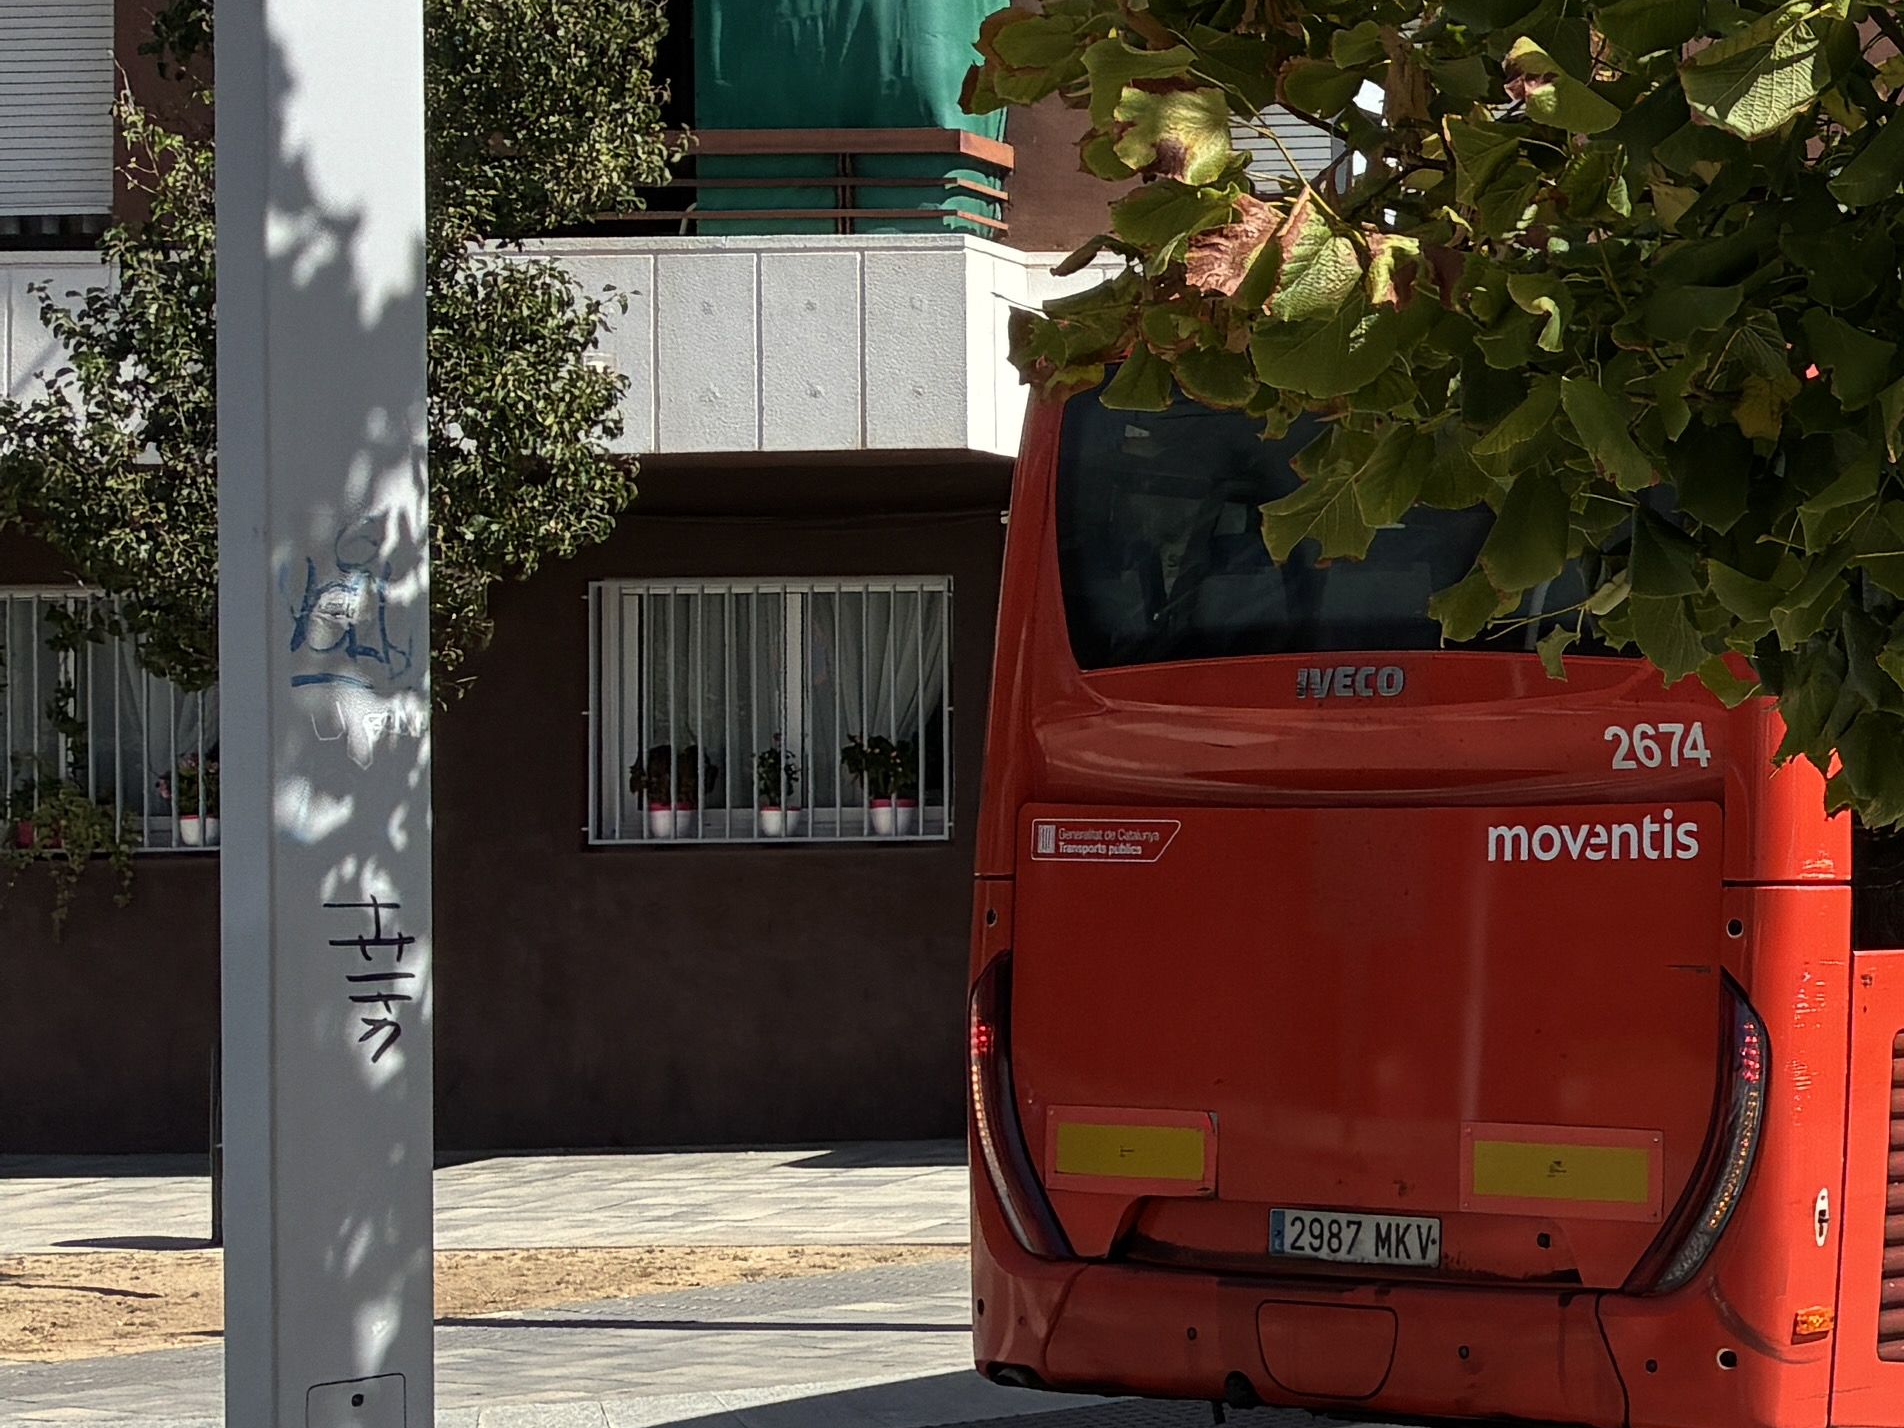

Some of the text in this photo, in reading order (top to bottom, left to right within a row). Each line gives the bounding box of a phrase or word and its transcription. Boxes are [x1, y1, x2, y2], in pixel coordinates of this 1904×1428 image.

[1297, 667, 1404, 699] IVECO
[1604, 722, 1711, 770] 2674
[1058, 827, 1161, 843] Generalitat de Catalunya
[1058, 842, 1107, 856] Transports
[1488, 808, 1699, 862] moventis
[1290, 1216, 1433, 1261] 2987 MKV
